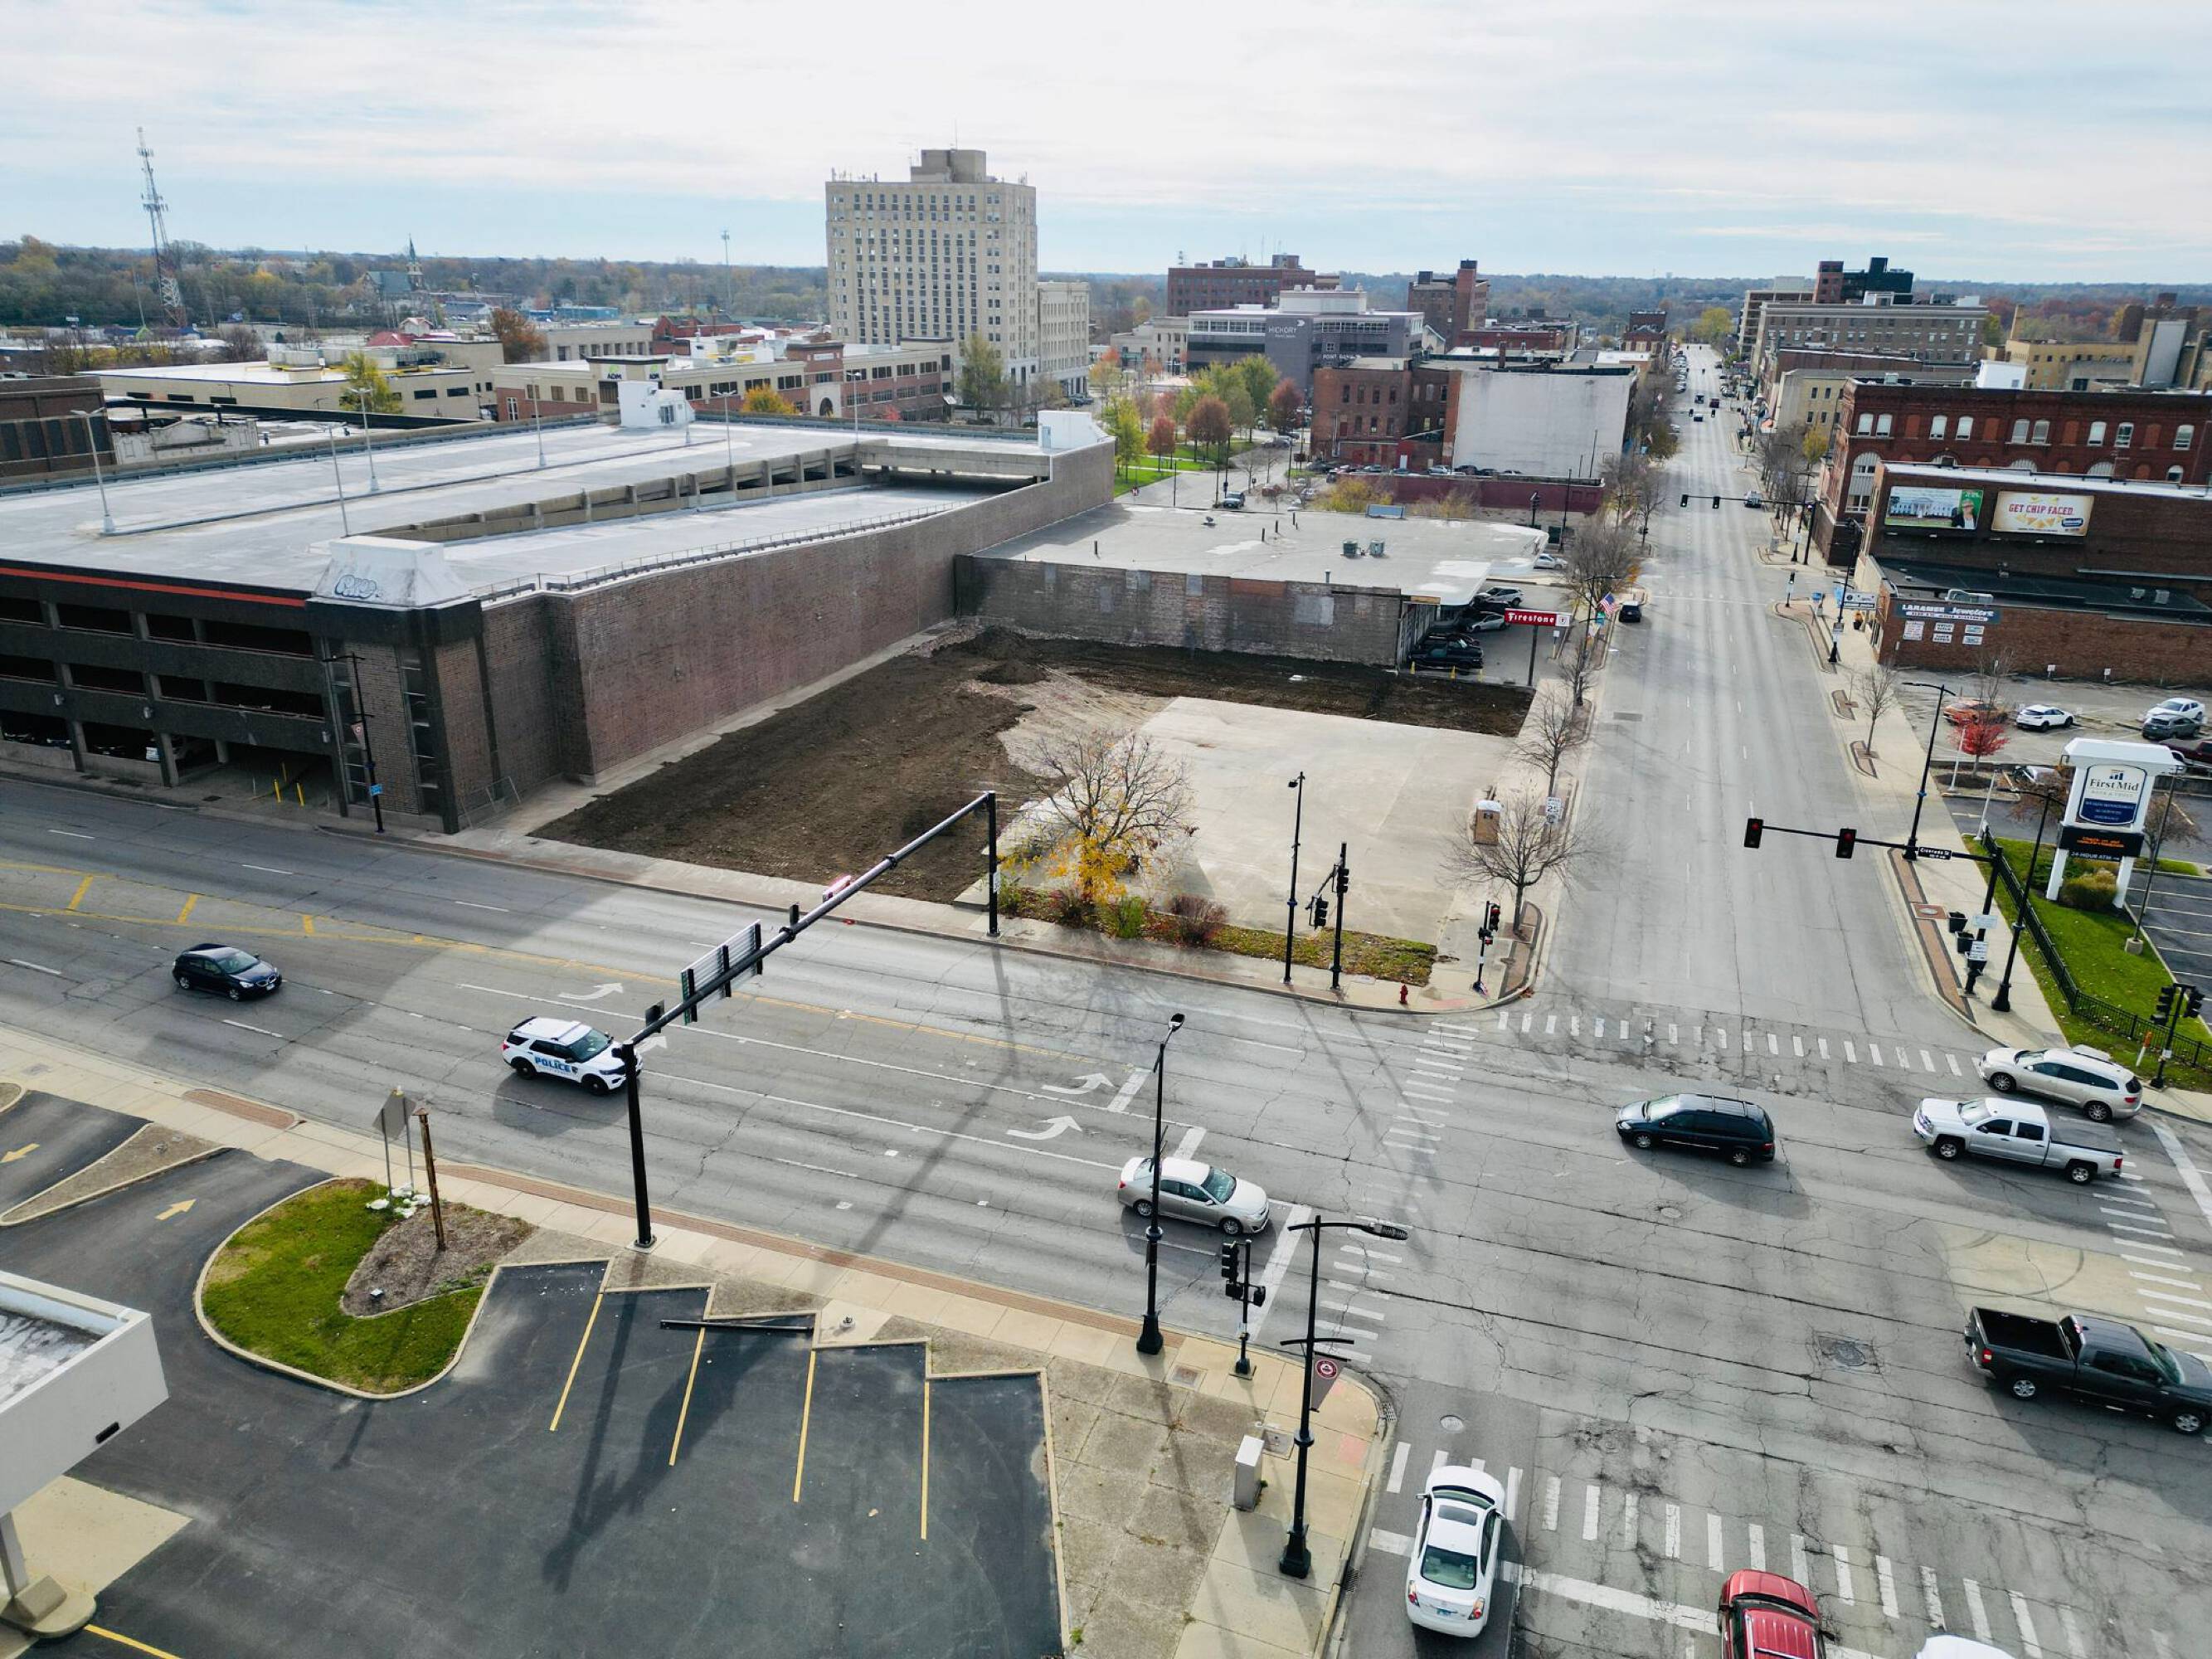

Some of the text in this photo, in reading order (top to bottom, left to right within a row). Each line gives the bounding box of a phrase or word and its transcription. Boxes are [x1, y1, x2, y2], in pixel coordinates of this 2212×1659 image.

[1268, 325, 1297, 333] HICKORY
[2008, 504, 2025, 513] GET
[2025, 504, 2046, 514] CHIP
[1508, 612, 1555, 623] Firestone
[2090, 778, 2139, 791] First Mid
[535, 1057, 571, 1073] POLICE
